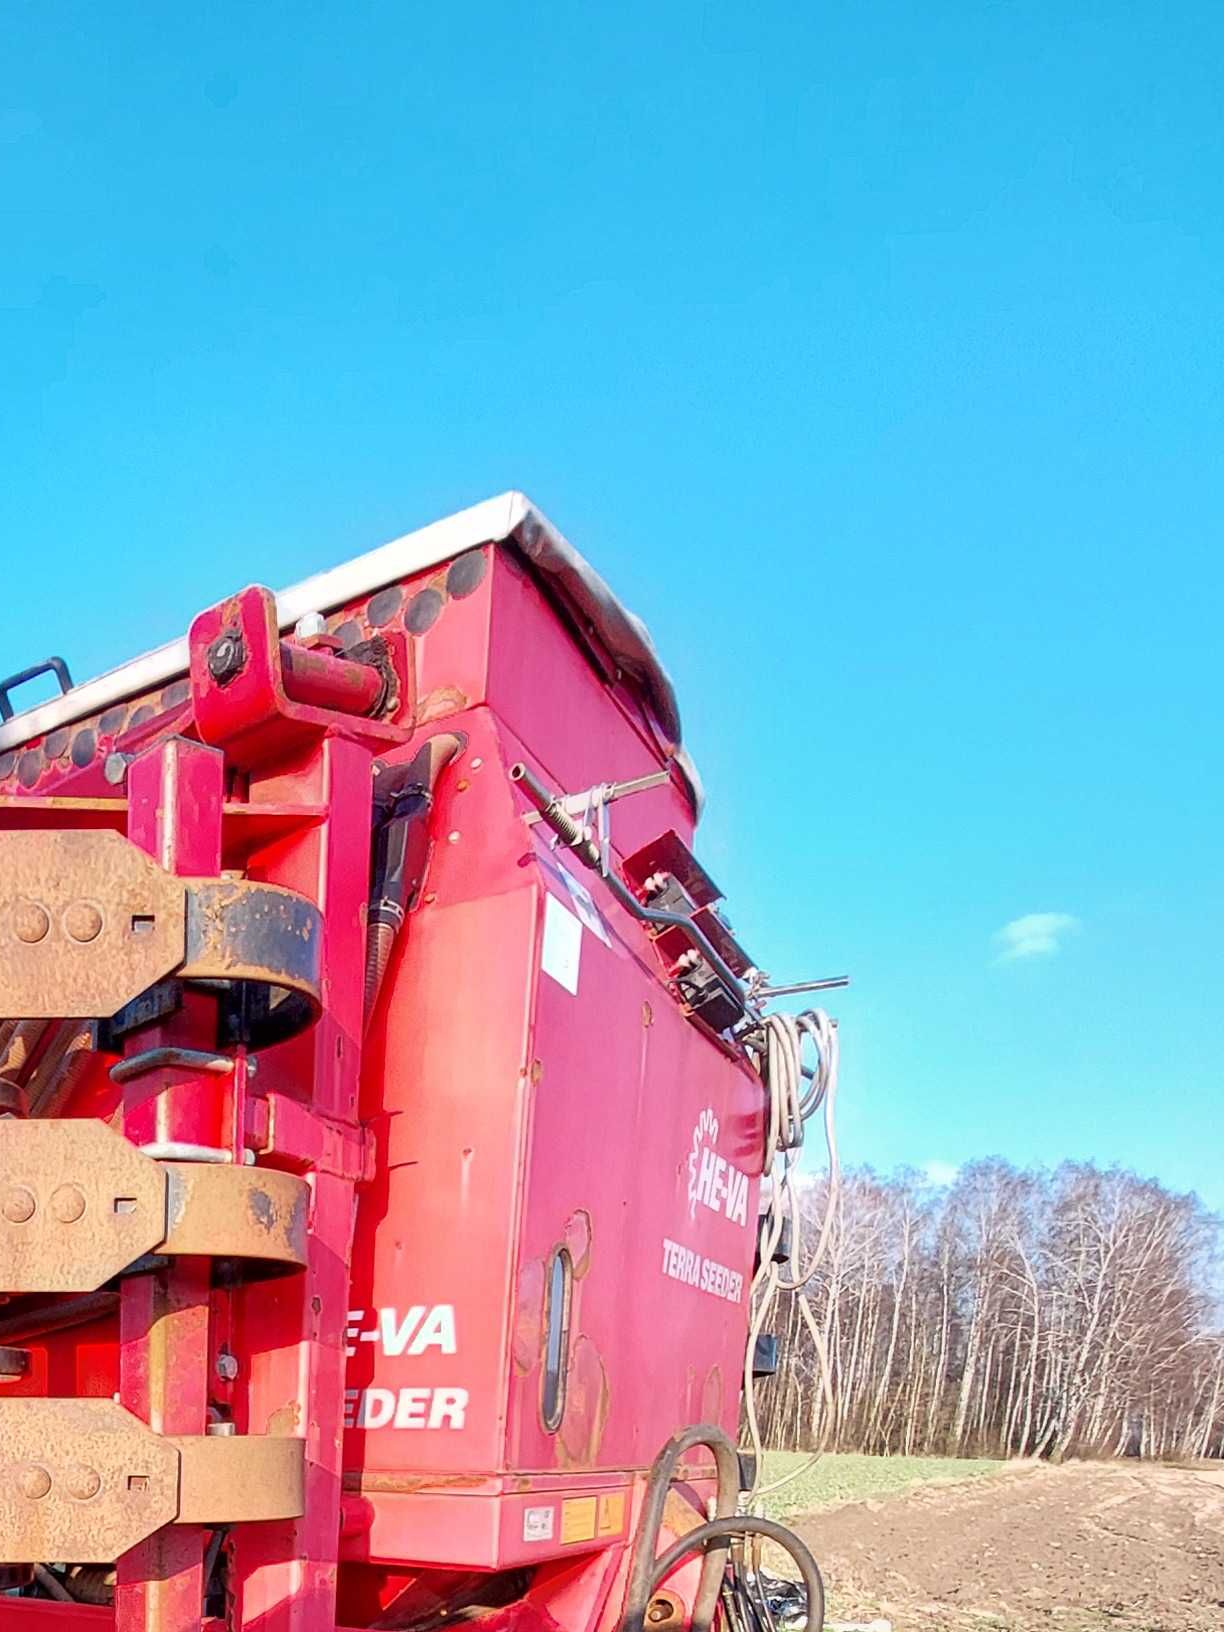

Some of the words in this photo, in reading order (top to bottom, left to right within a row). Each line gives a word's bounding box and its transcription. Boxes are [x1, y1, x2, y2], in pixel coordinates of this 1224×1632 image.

[696, 1147, 750, 1227] HE-VA
[662, 1237, 701, 1288] TERRA
[700, 1258, 744, 1304] SEEDER
